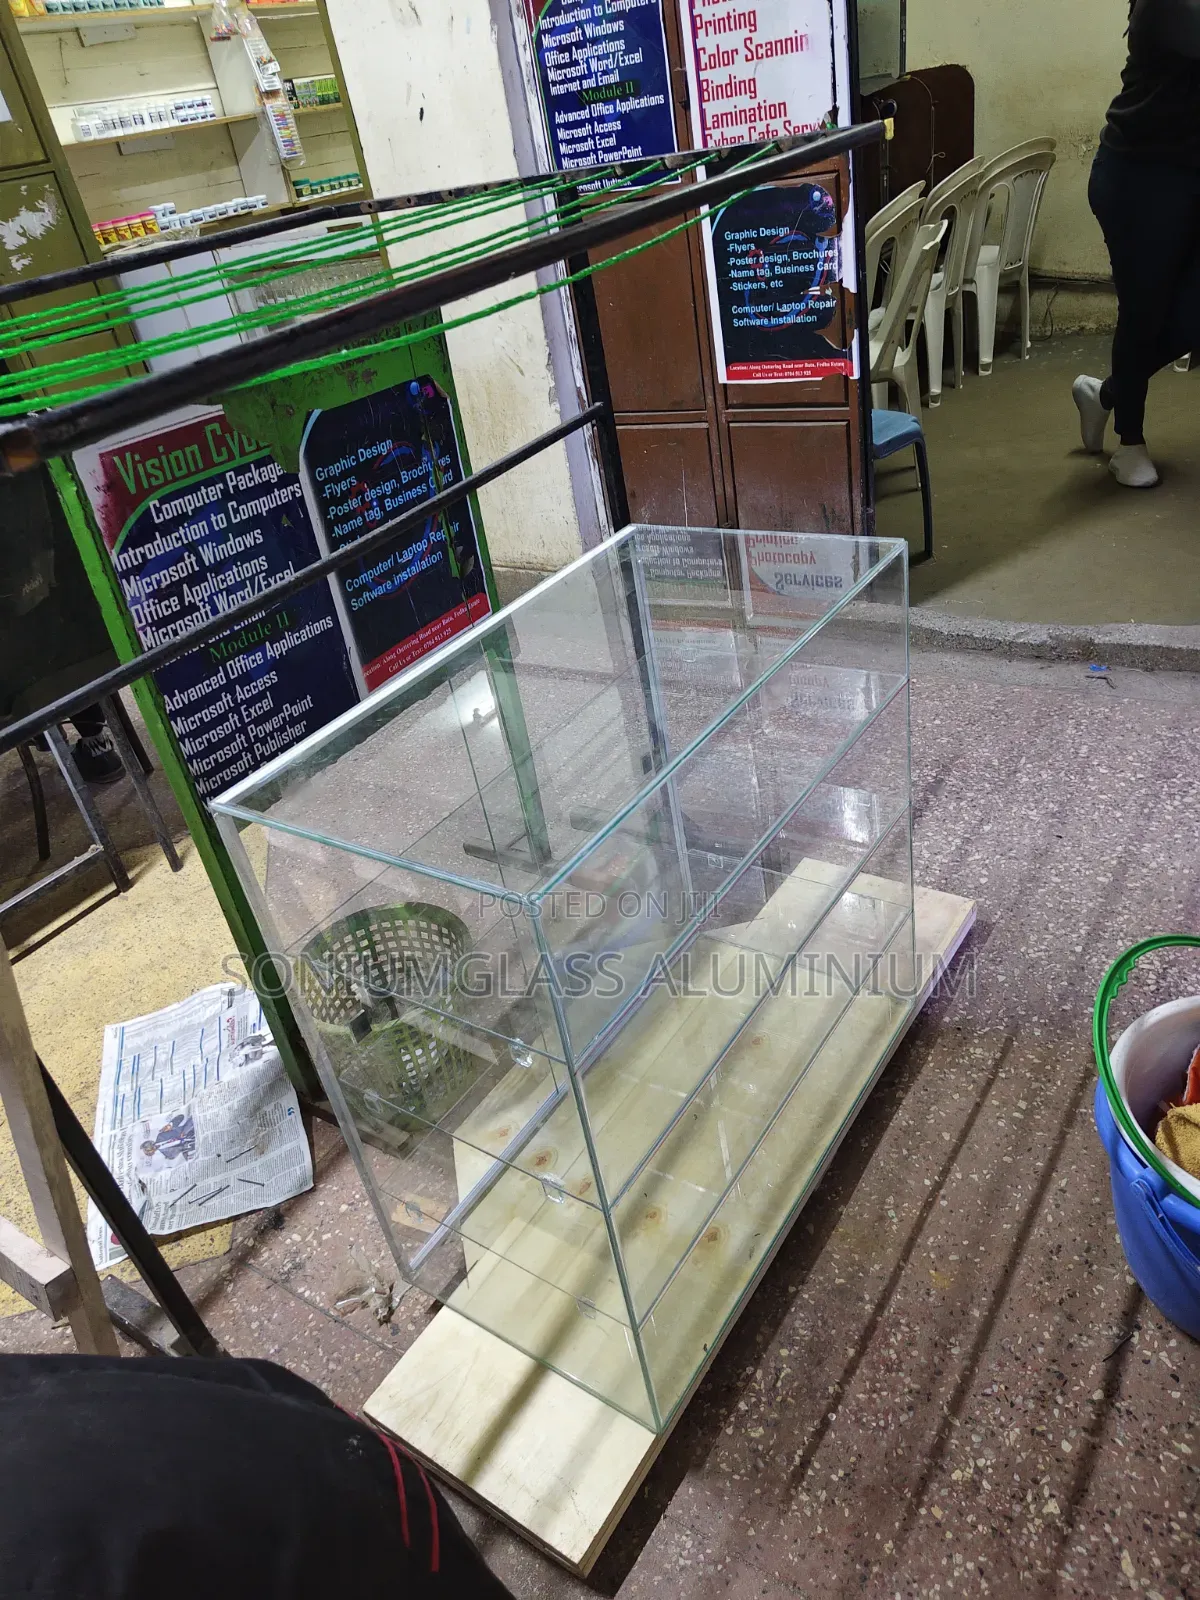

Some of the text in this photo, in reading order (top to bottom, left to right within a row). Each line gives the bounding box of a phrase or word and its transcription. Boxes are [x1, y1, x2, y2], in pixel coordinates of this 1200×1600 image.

[539, 7, 592, 30] Introduction
[593, 5, 604, 17] to
[693, 8, 758, 39] Printing
[541, 20, 625, 49] Microsoft Windows
[544, 39, 625, 67] Office Applications
[547, 47, 643, 82] Microsoft Word/Excel
[697, 30, 810, 72] Color Scannin
[549, 69, 620, 96] Internet and Email
[582, 86, 623, 102] Module
[701, 73, 758, 103] Binding
[555, 94, 665, 125] Advanced Office Applications
[703, 99, 788, 131] Lamination
[557, 120, 622, 141] Microsoft Access
[559, 133, 617, 155] Microsoft Excel
[561, 152, 598, 170] Microsoft
[598, 145, 643, 163] PowerPoint
[724, 225, 790, 242] Graphic Design
[727, 242, 756, 254] -Flyers
[727, 249, 839, 267] -Poster design, Brochures
[728, 268, 755, 279] -Name
[756, 267, 773, 279] tag,
[774, 264, 815, 275] Business
[729, 280, 784, 292] -Stickers, etc
[733, 316, 769, 328] Software
[776, 301, 806, 314] Laptop
[807, 299, 837, 311] Repair
[112, 443, 204, 495] Vision
[315, 438, 393, 482] Graphic Design
[149, 462, 287, 525] Computer Package
[322, 475, 357, 500] -Flyers
[327, 498, 363, 520] -Poster
[364, 480, 400, 502] design,
[331, 515, 364, 538] -Name
[364, 506, 384, 522] tag,
[385, 483, 428, 512] Business
[112, 482, 303, 573] Introduction to Computers
[122, 528, 264, 601] Microsoft Windows
[345, 554, 395, 592] Computer/
[396, 538, 428, 563] Laptop
[429, 521, 460, 545] Repir
[130, 555, 268, 629] Office Applications
[351, 581, 393, 611] Software
[138, 602, 213, 652] Microsoft
[209, 622, 272, 663] Module
[164, 666, 227, 715] Advanced
[226, 652, 264, 680] Office
[265, 615, 334, 660] Applications
[171, 670, 278, 739] Microsoft Access
[179, 713, 242, 759] Microsoft
[241, 692, 274, 723] Excel
[187, 733, 249, 777] Microsoft
[248, 694, 314, 743] PowerPoint
[195, 752, 255, 796] Microsoft
[254, 720, 307, 761] Publisher
